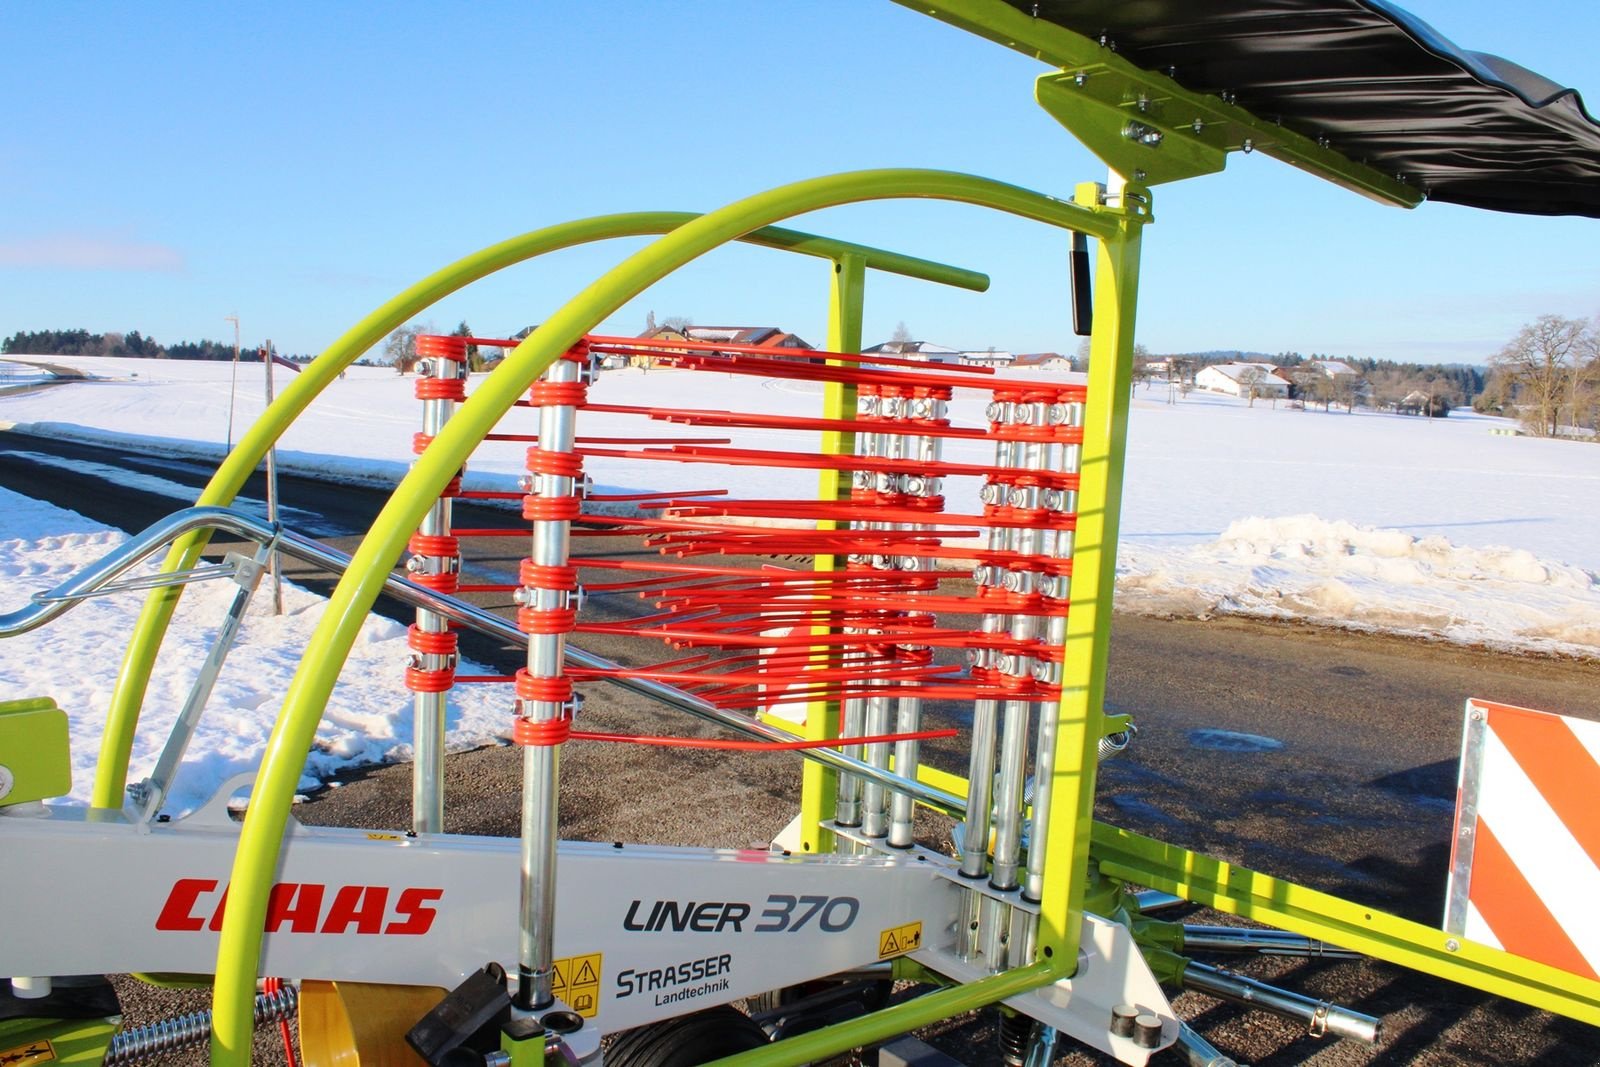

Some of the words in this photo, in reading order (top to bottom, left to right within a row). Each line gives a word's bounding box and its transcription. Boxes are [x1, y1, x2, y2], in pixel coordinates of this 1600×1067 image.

[623, 900, 750, 932] LINER
[754, 894, 860, 933] 370
[616, 954, 732, 998] STRASSER
[655, 978, 730, 1007] Landtechnik
